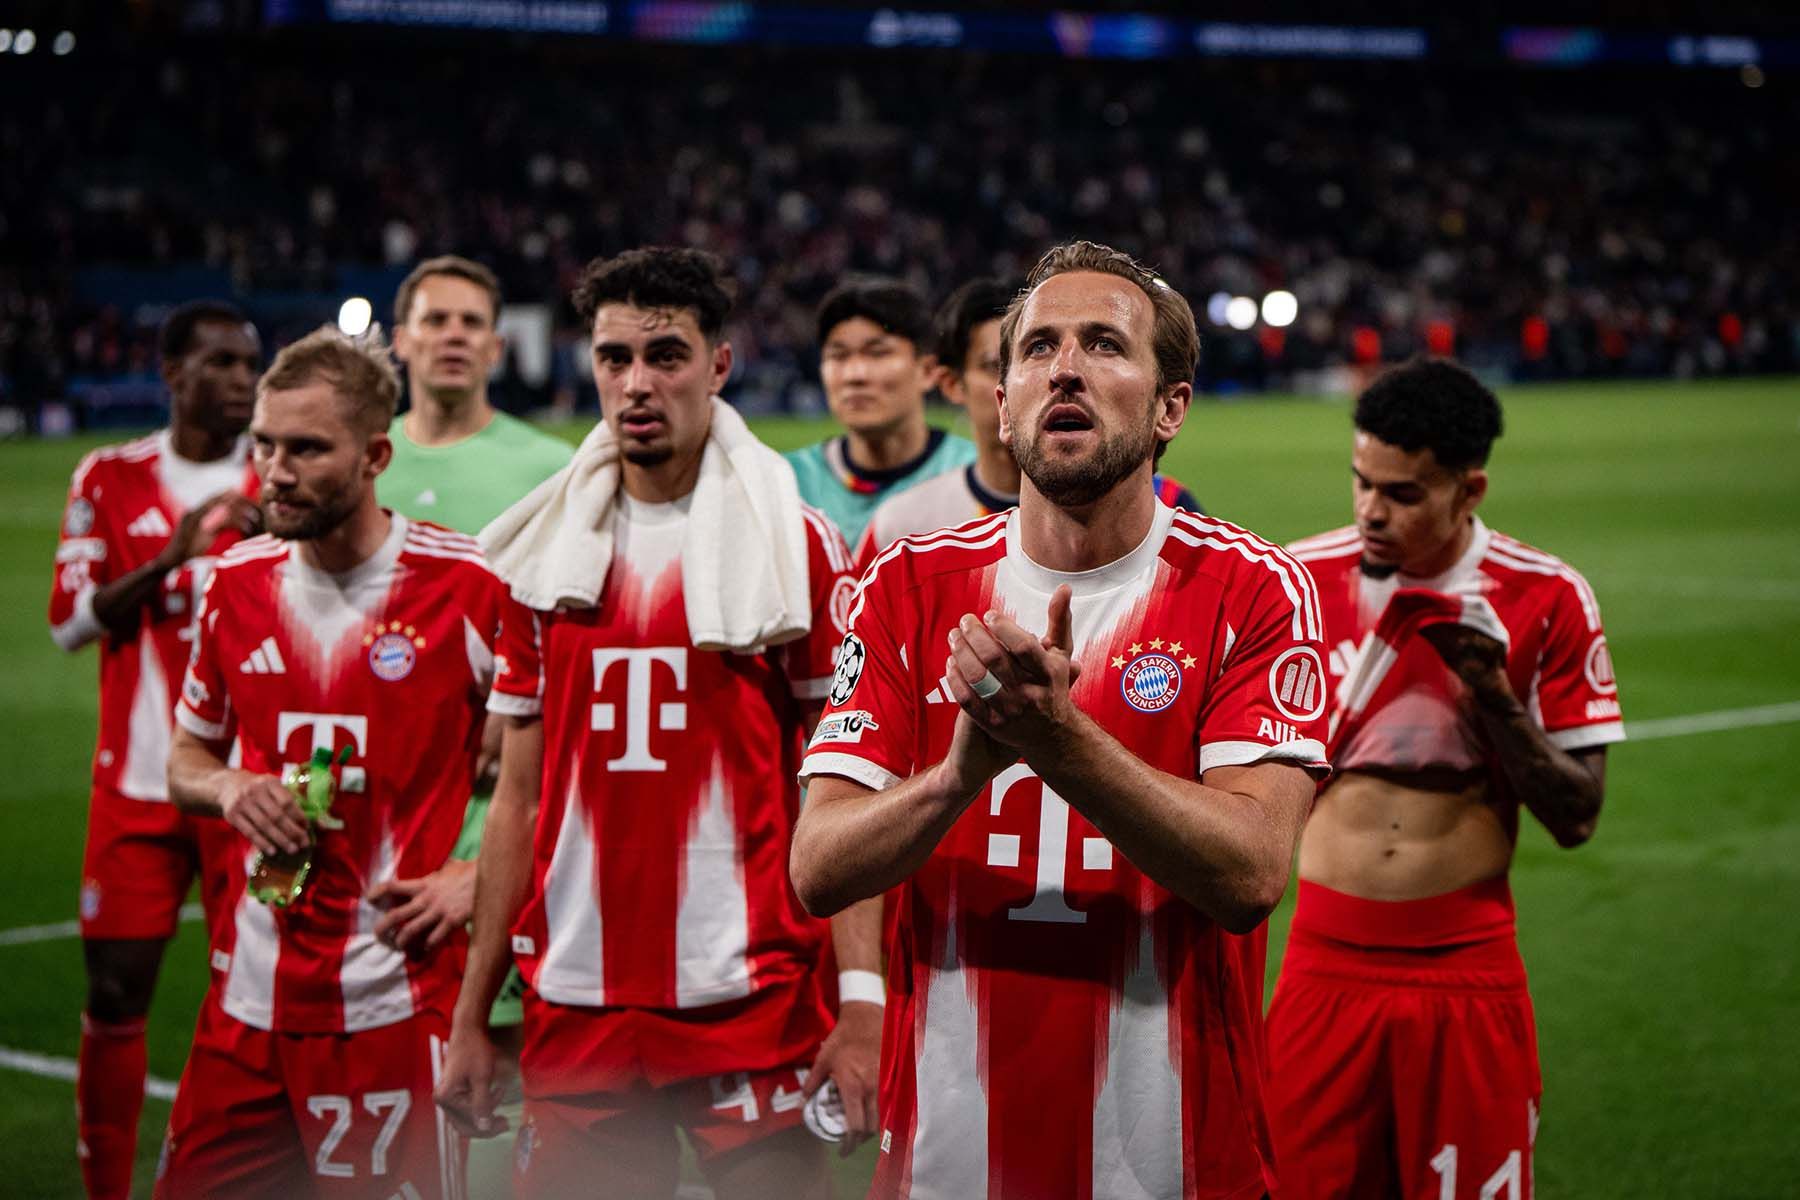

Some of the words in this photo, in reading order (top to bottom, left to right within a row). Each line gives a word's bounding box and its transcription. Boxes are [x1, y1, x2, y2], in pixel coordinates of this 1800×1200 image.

[1127, 665, 1140, 680] FC
[1140, 657, 1178, 680] BAYERN
[591, 647, 688, 772] T
[843, 716, 863, 733] 10
[986, 762, 1113, 923] T
[306, 1088, 412, 1178] 27
[1429, 1143, 1522, 1200] 14
